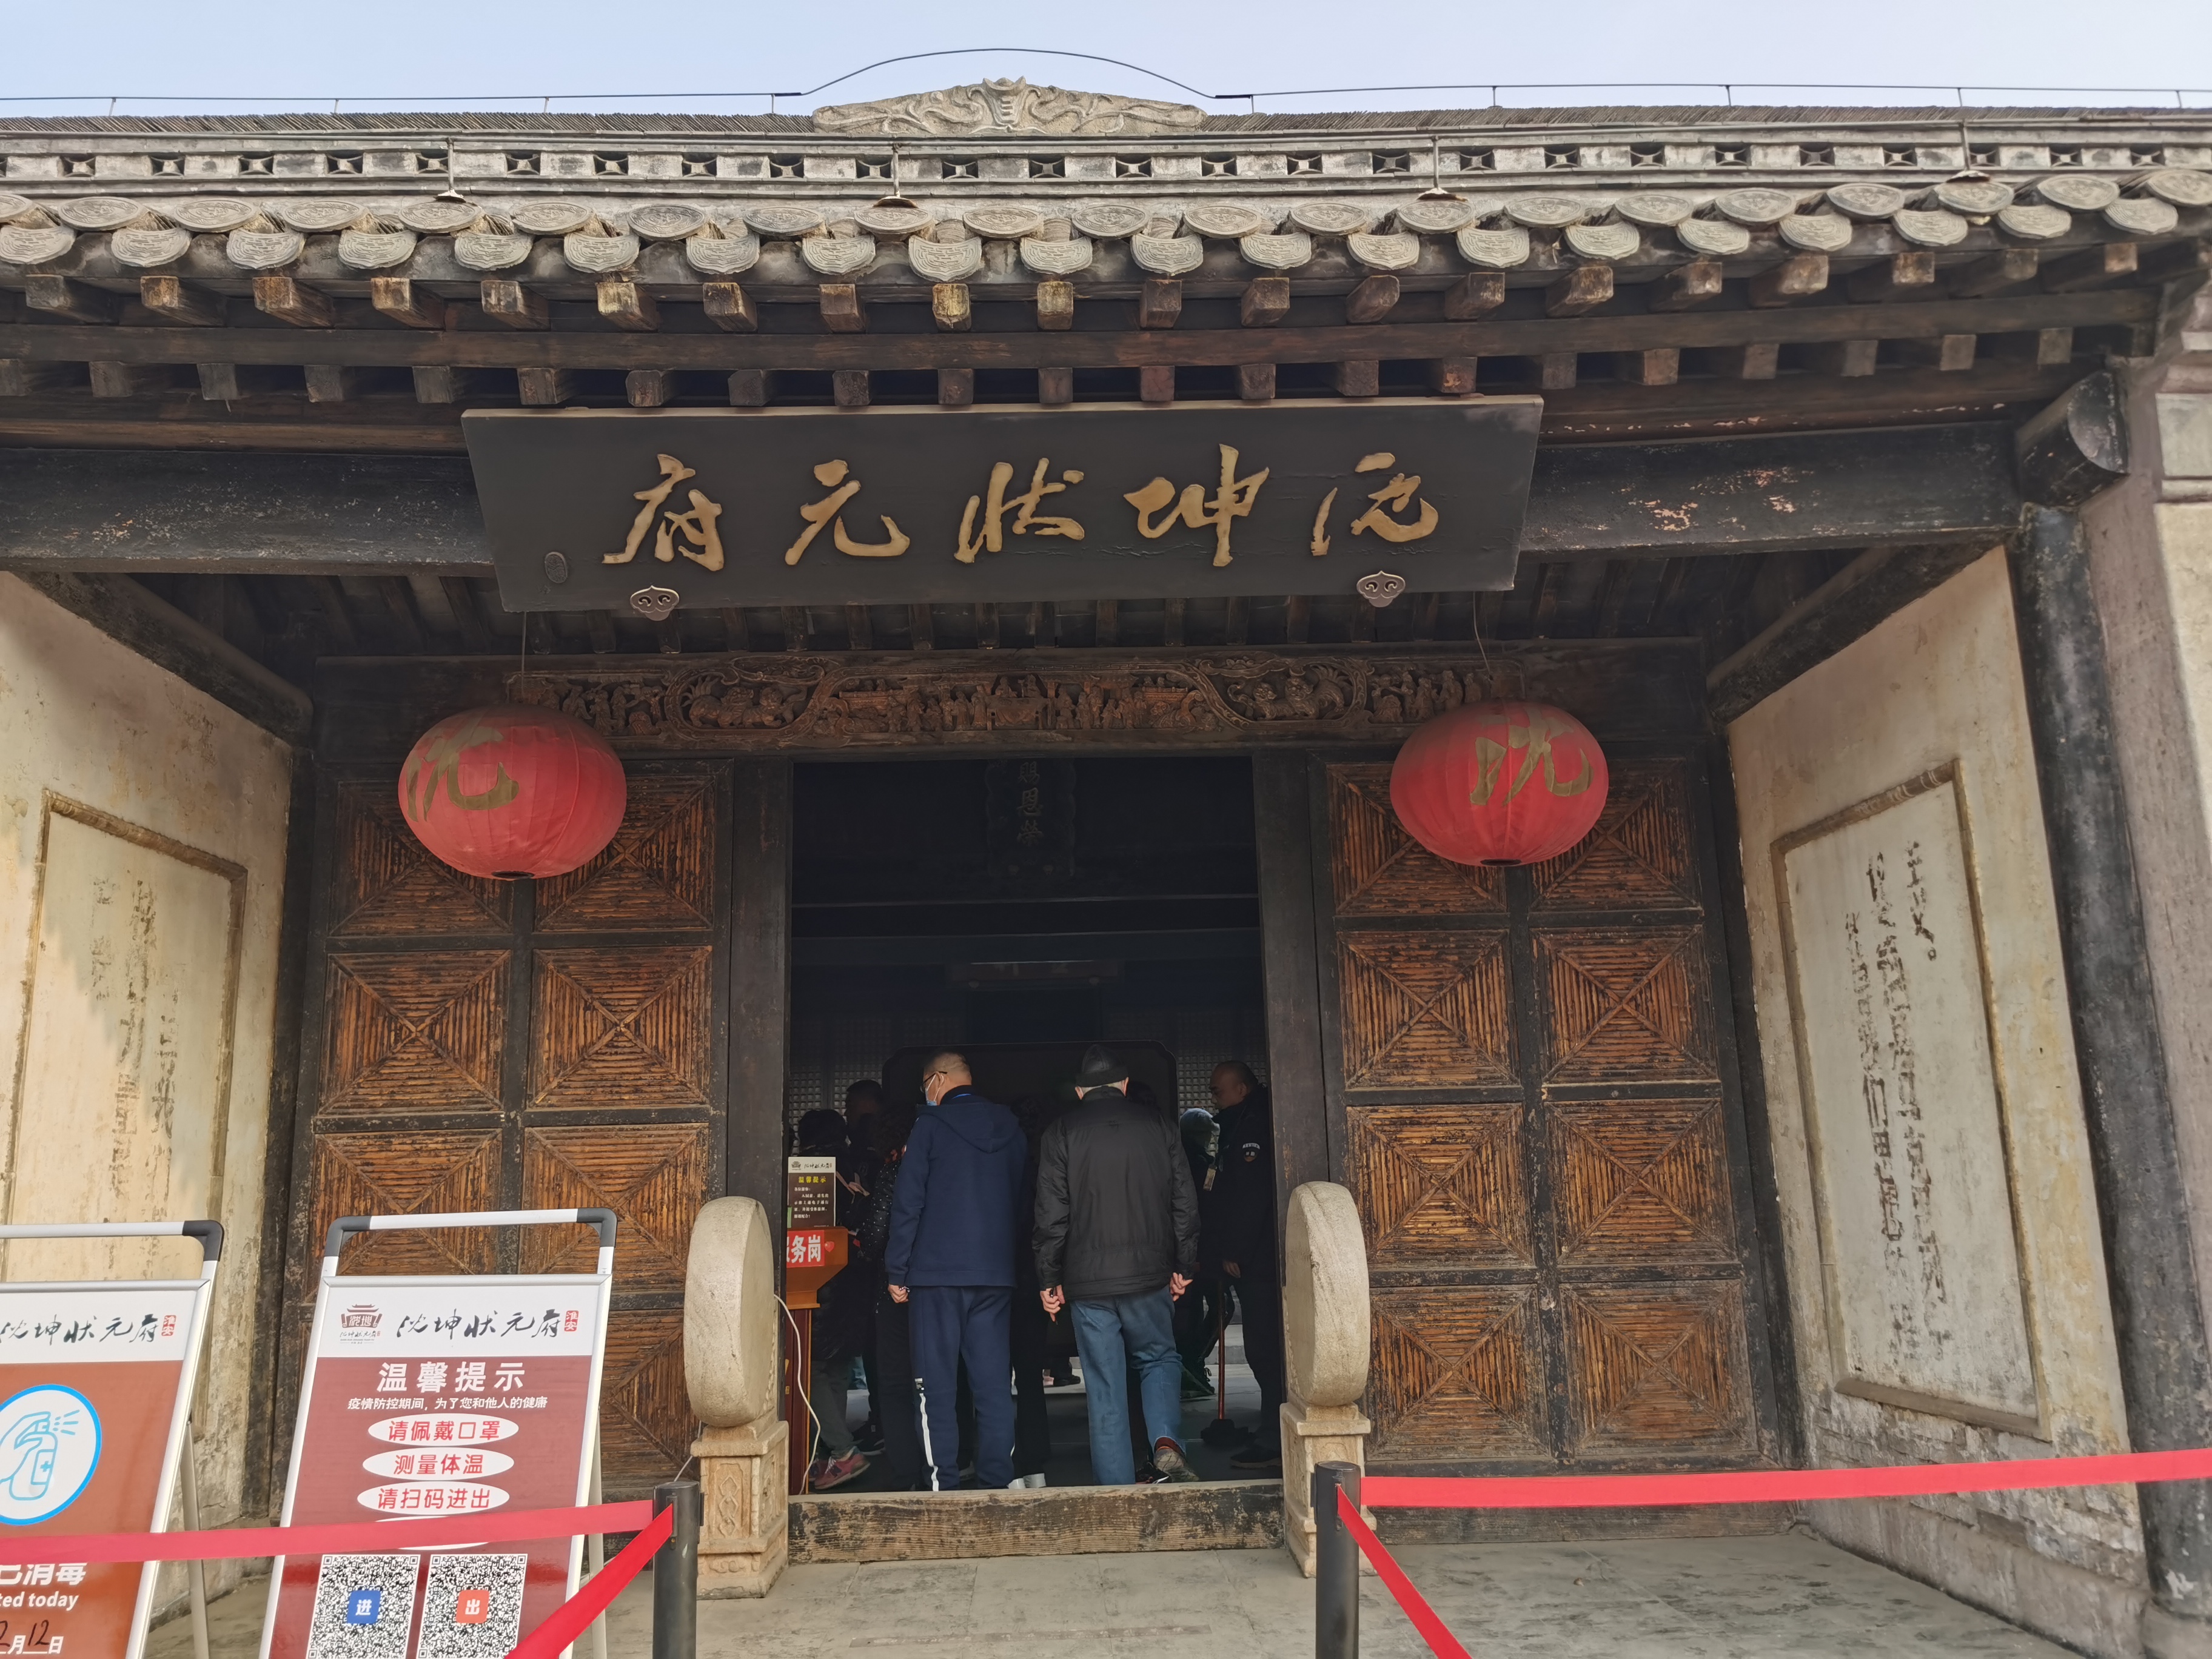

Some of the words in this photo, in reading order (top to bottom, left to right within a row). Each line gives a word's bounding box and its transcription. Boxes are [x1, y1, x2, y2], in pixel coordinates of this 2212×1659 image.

[377, 1361, 525, 1393] 温馨提示
[347, 1396, 548, 1410] 疫情防控期间，为了您和他人的健康
[388, 1420, 501, 1441] 请佩戴口罩
[394, 1454, 484, 1475] 测量体温
[377, 1488, 491, 1509] 请扫码进出
[28, 1590, 79, 1611] today
[355, 1600, 372, 1616] 进
[465, 1599, 480, 1615] 出
